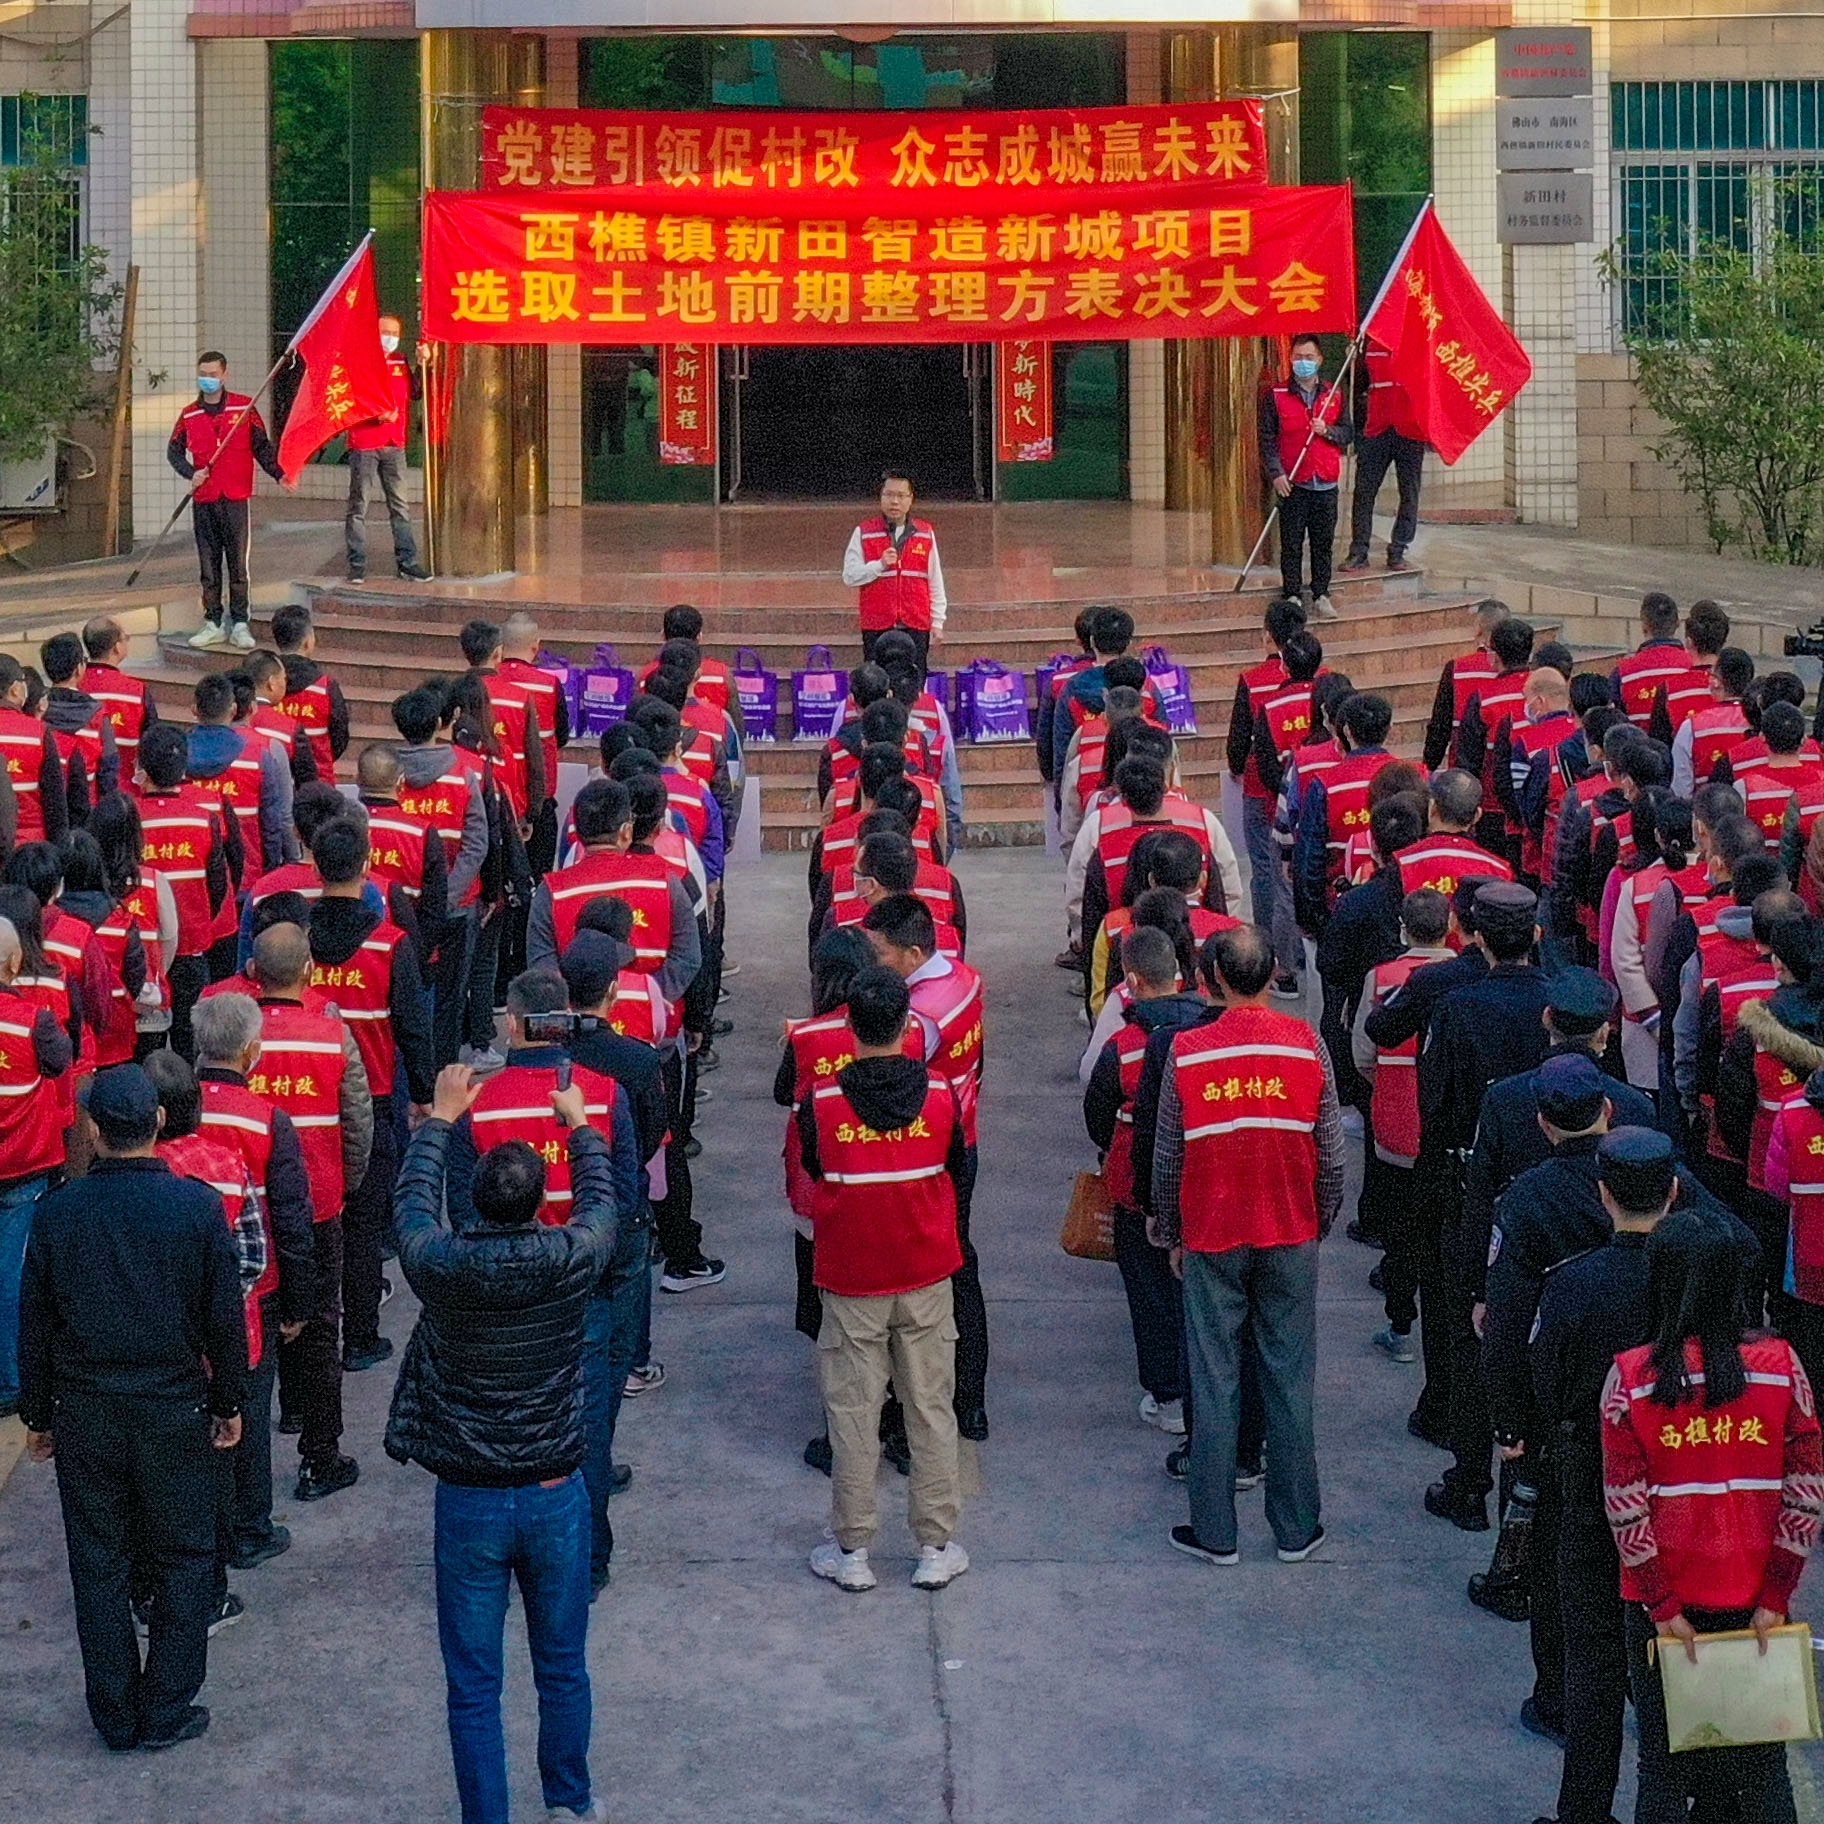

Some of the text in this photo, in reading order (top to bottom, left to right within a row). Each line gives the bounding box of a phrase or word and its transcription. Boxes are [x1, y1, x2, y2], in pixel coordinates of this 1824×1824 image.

[496, 113, 1253, 188] 党建引领促村改 众志成城赢未来
[1523, 189, 1567, 204] 新田村
[519, 209, 1254, 264] 西樵镇新田智造新城项目
[450, 261, 1327, 325] 选取土地前期整理方表决大会
[1201, 1076, 1288, 1103] 西樵村改
[1658, 1415, 1771, 1450] 西樵村改
